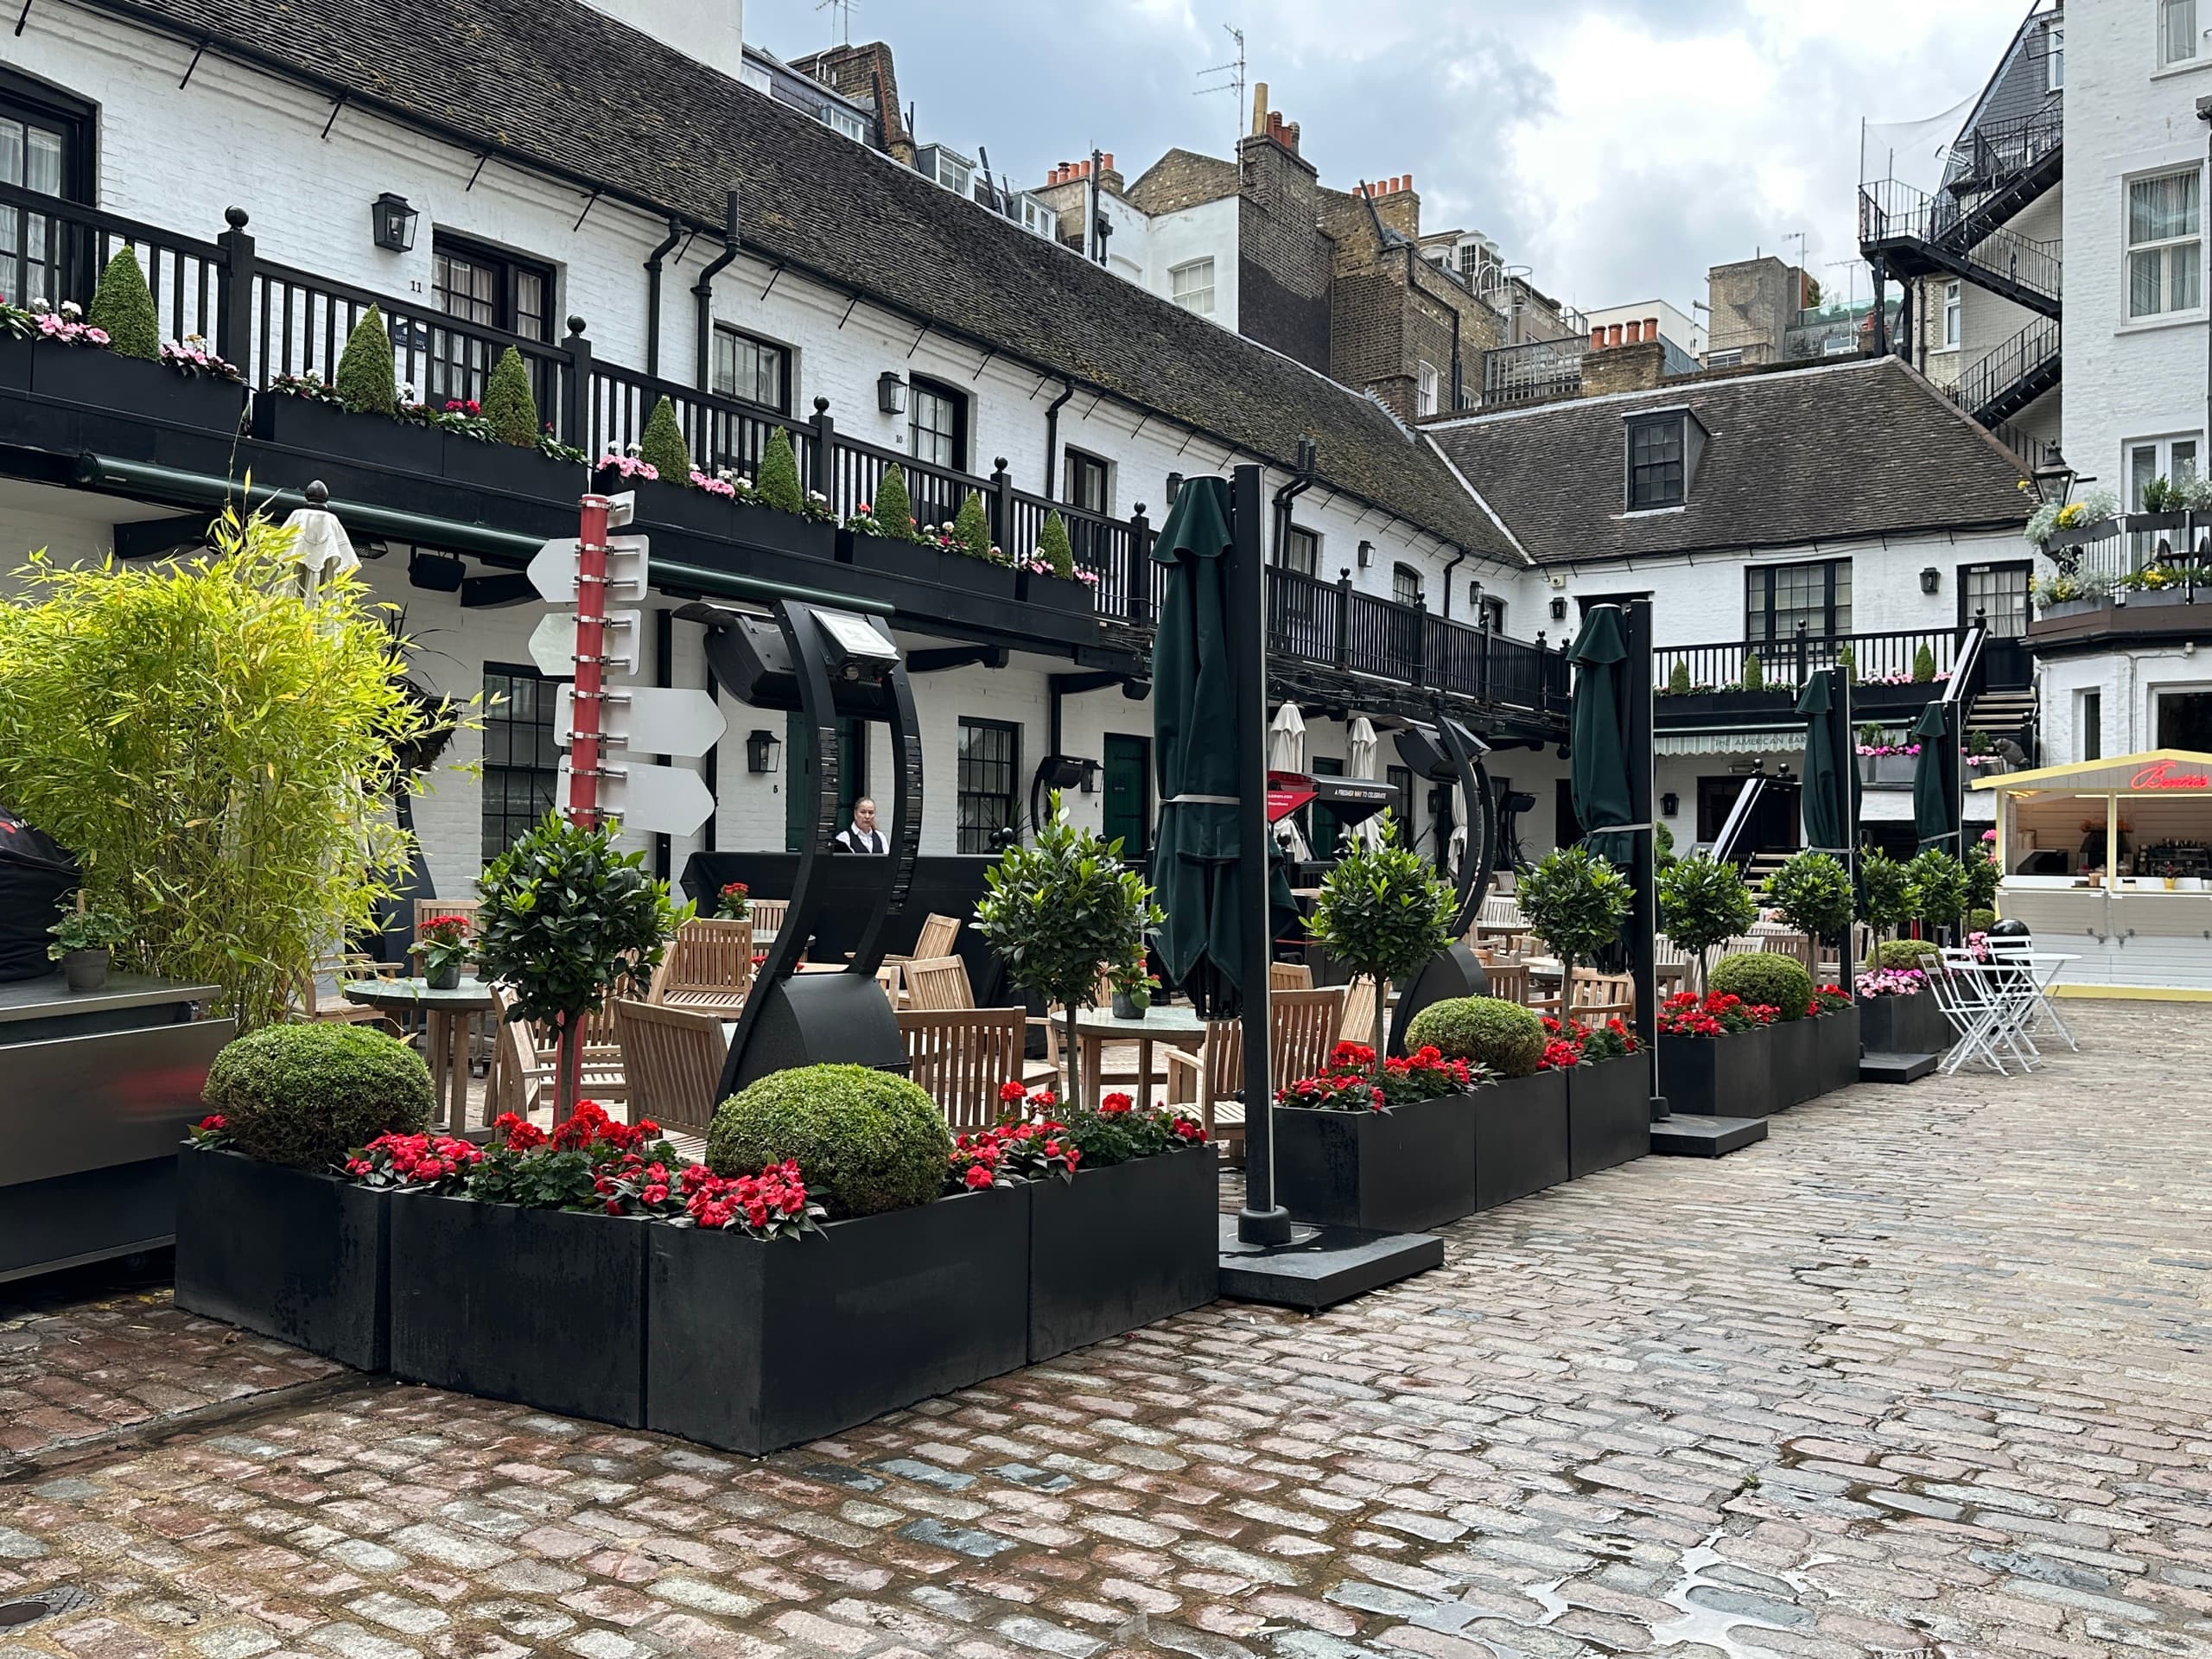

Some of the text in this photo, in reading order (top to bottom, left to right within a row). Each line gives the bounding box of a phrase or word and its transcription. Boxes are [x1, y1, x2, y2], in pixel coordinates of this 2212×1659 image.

[410, 280, 423, 293] 11
[895, 435, 903, 444] 10
[1734, 737, 1784, 746] AMERICAN
